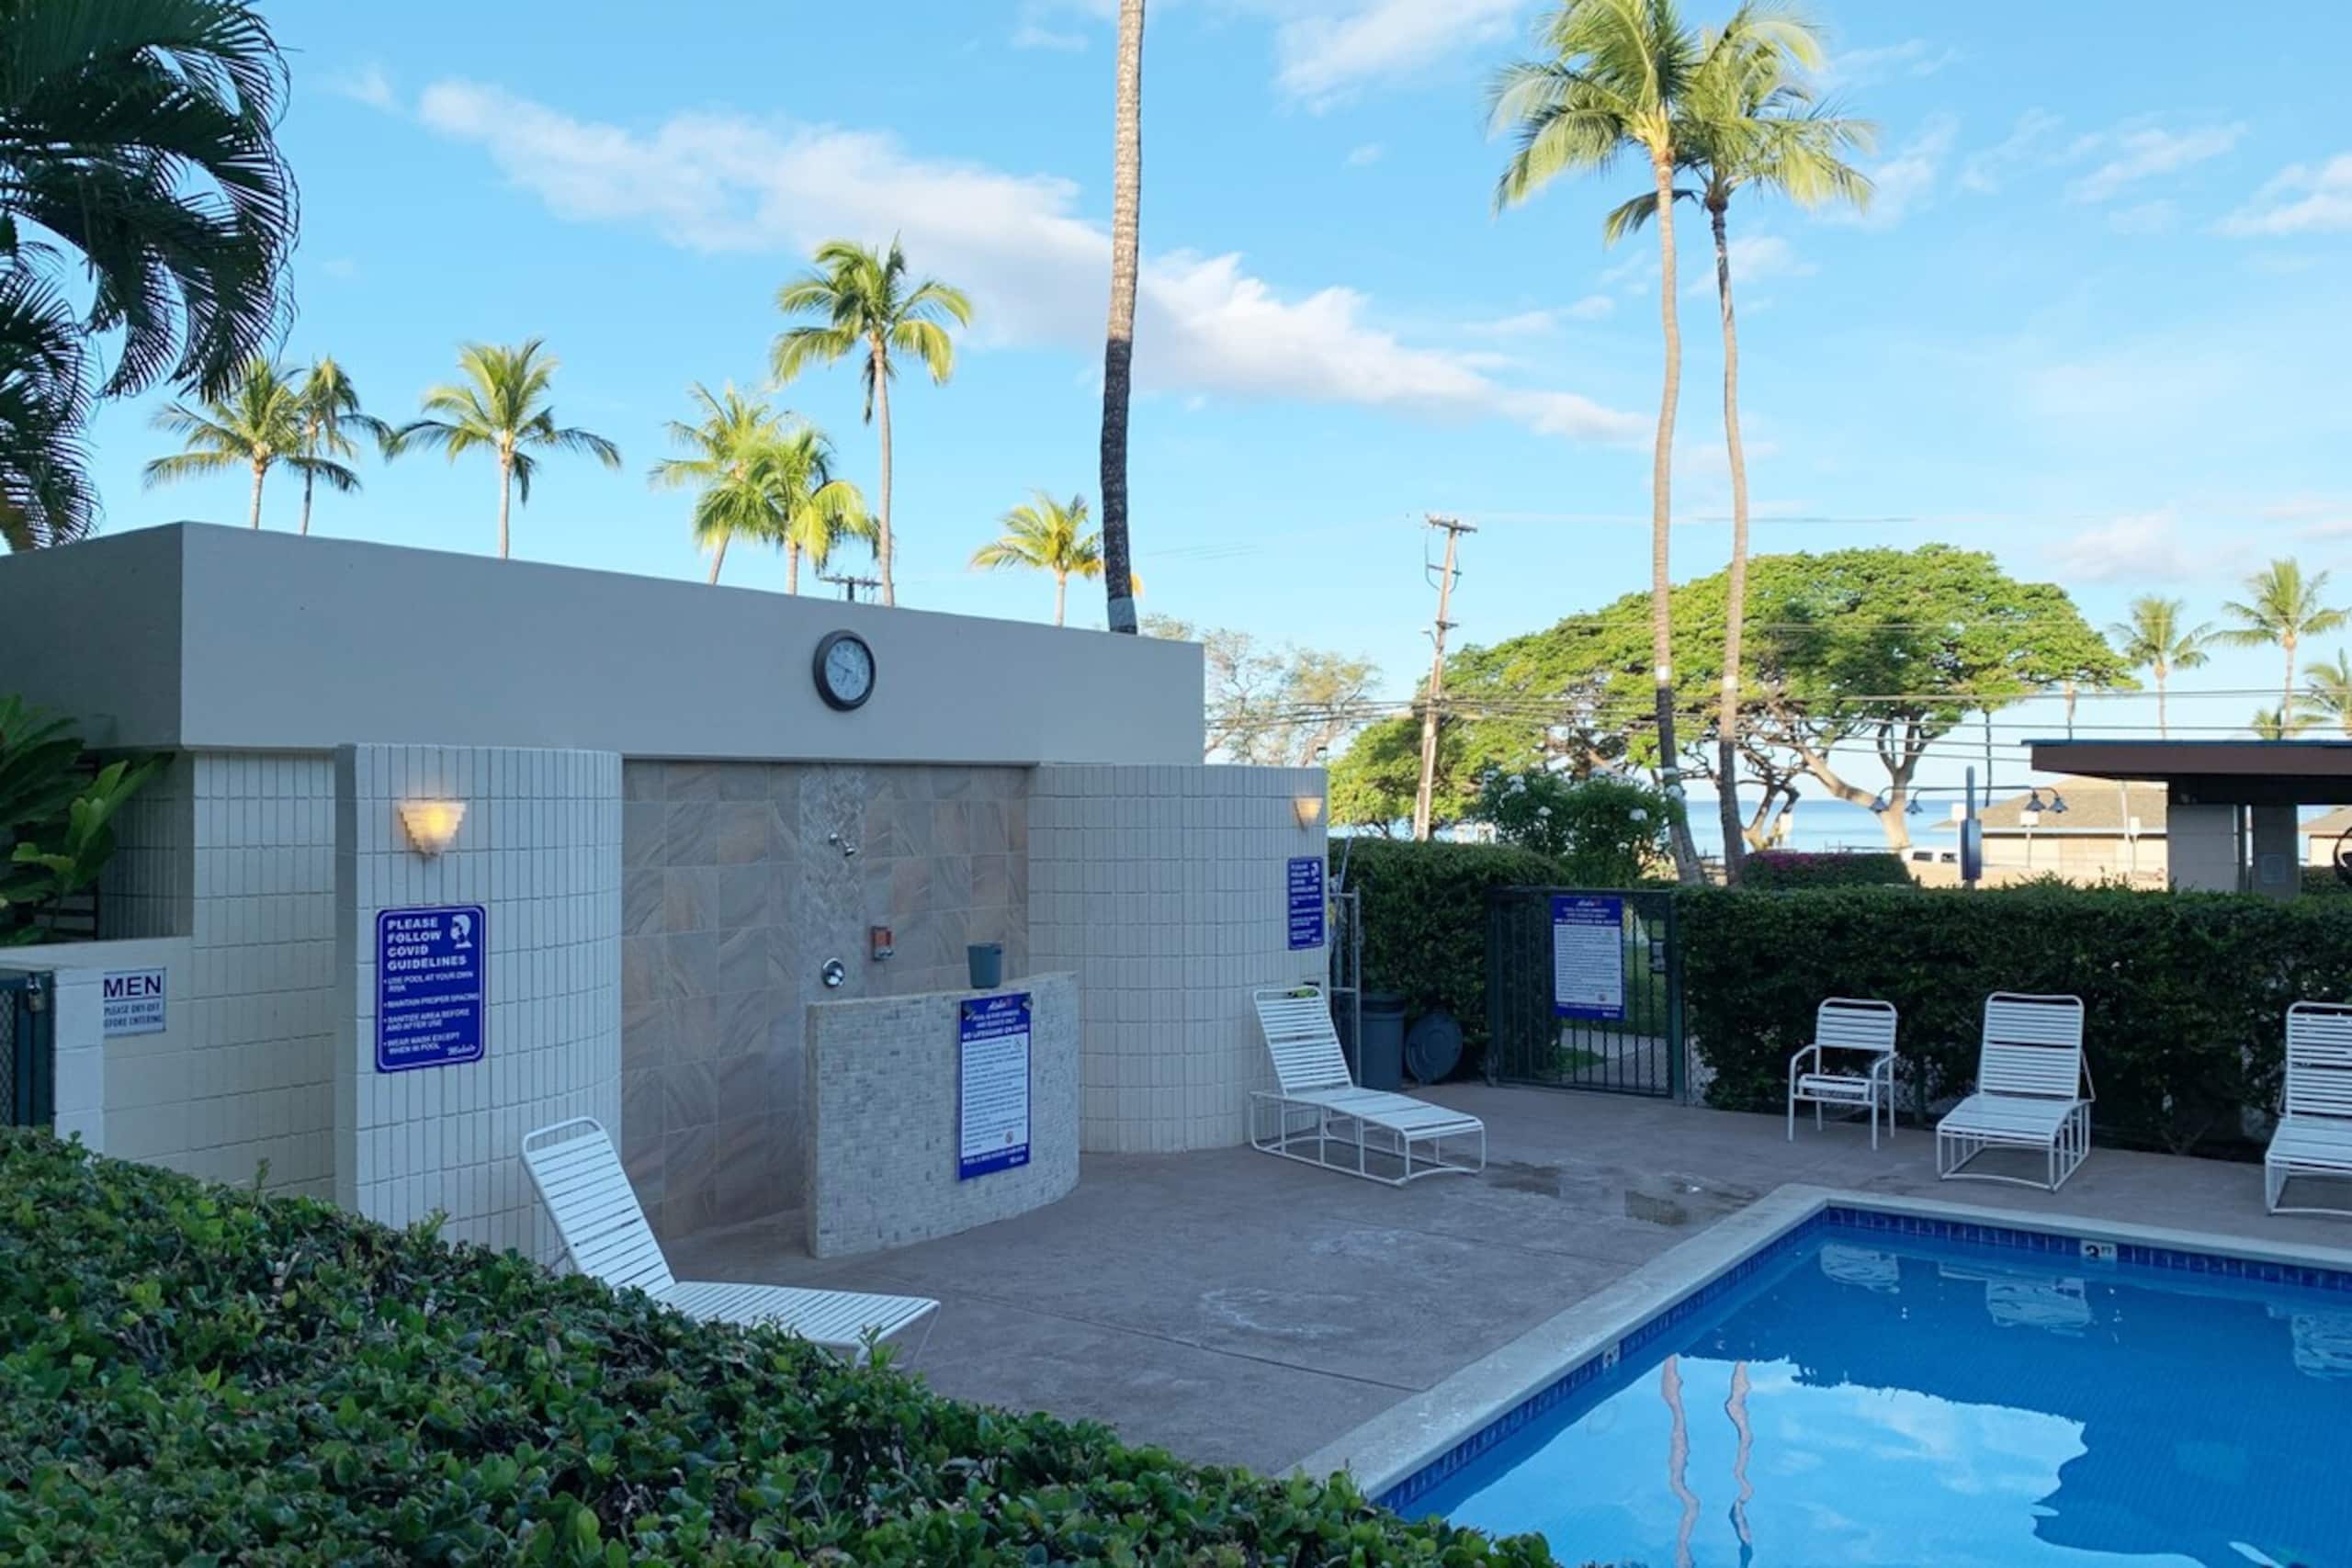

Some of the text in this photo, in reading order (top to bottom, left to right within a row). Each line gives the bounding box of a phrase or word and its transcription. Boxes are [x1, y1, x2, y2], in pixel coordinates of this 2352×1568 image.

[388, 917, 438, 929] PLEASE
[388, 931, 441, 943] FOLLOW
[388, 945, 428, 957] COVID
[388, 955, 467, 971] GUIDELINES
[104, 976, 160, 997] MEN
[104, 1005, 128, 1016] PLEASE
[441, 1009, 469, 1017] BEFORE
[404, 1021, 426, 1029] AFTER
[433, 1032, 459, 1041] EXCEPT
